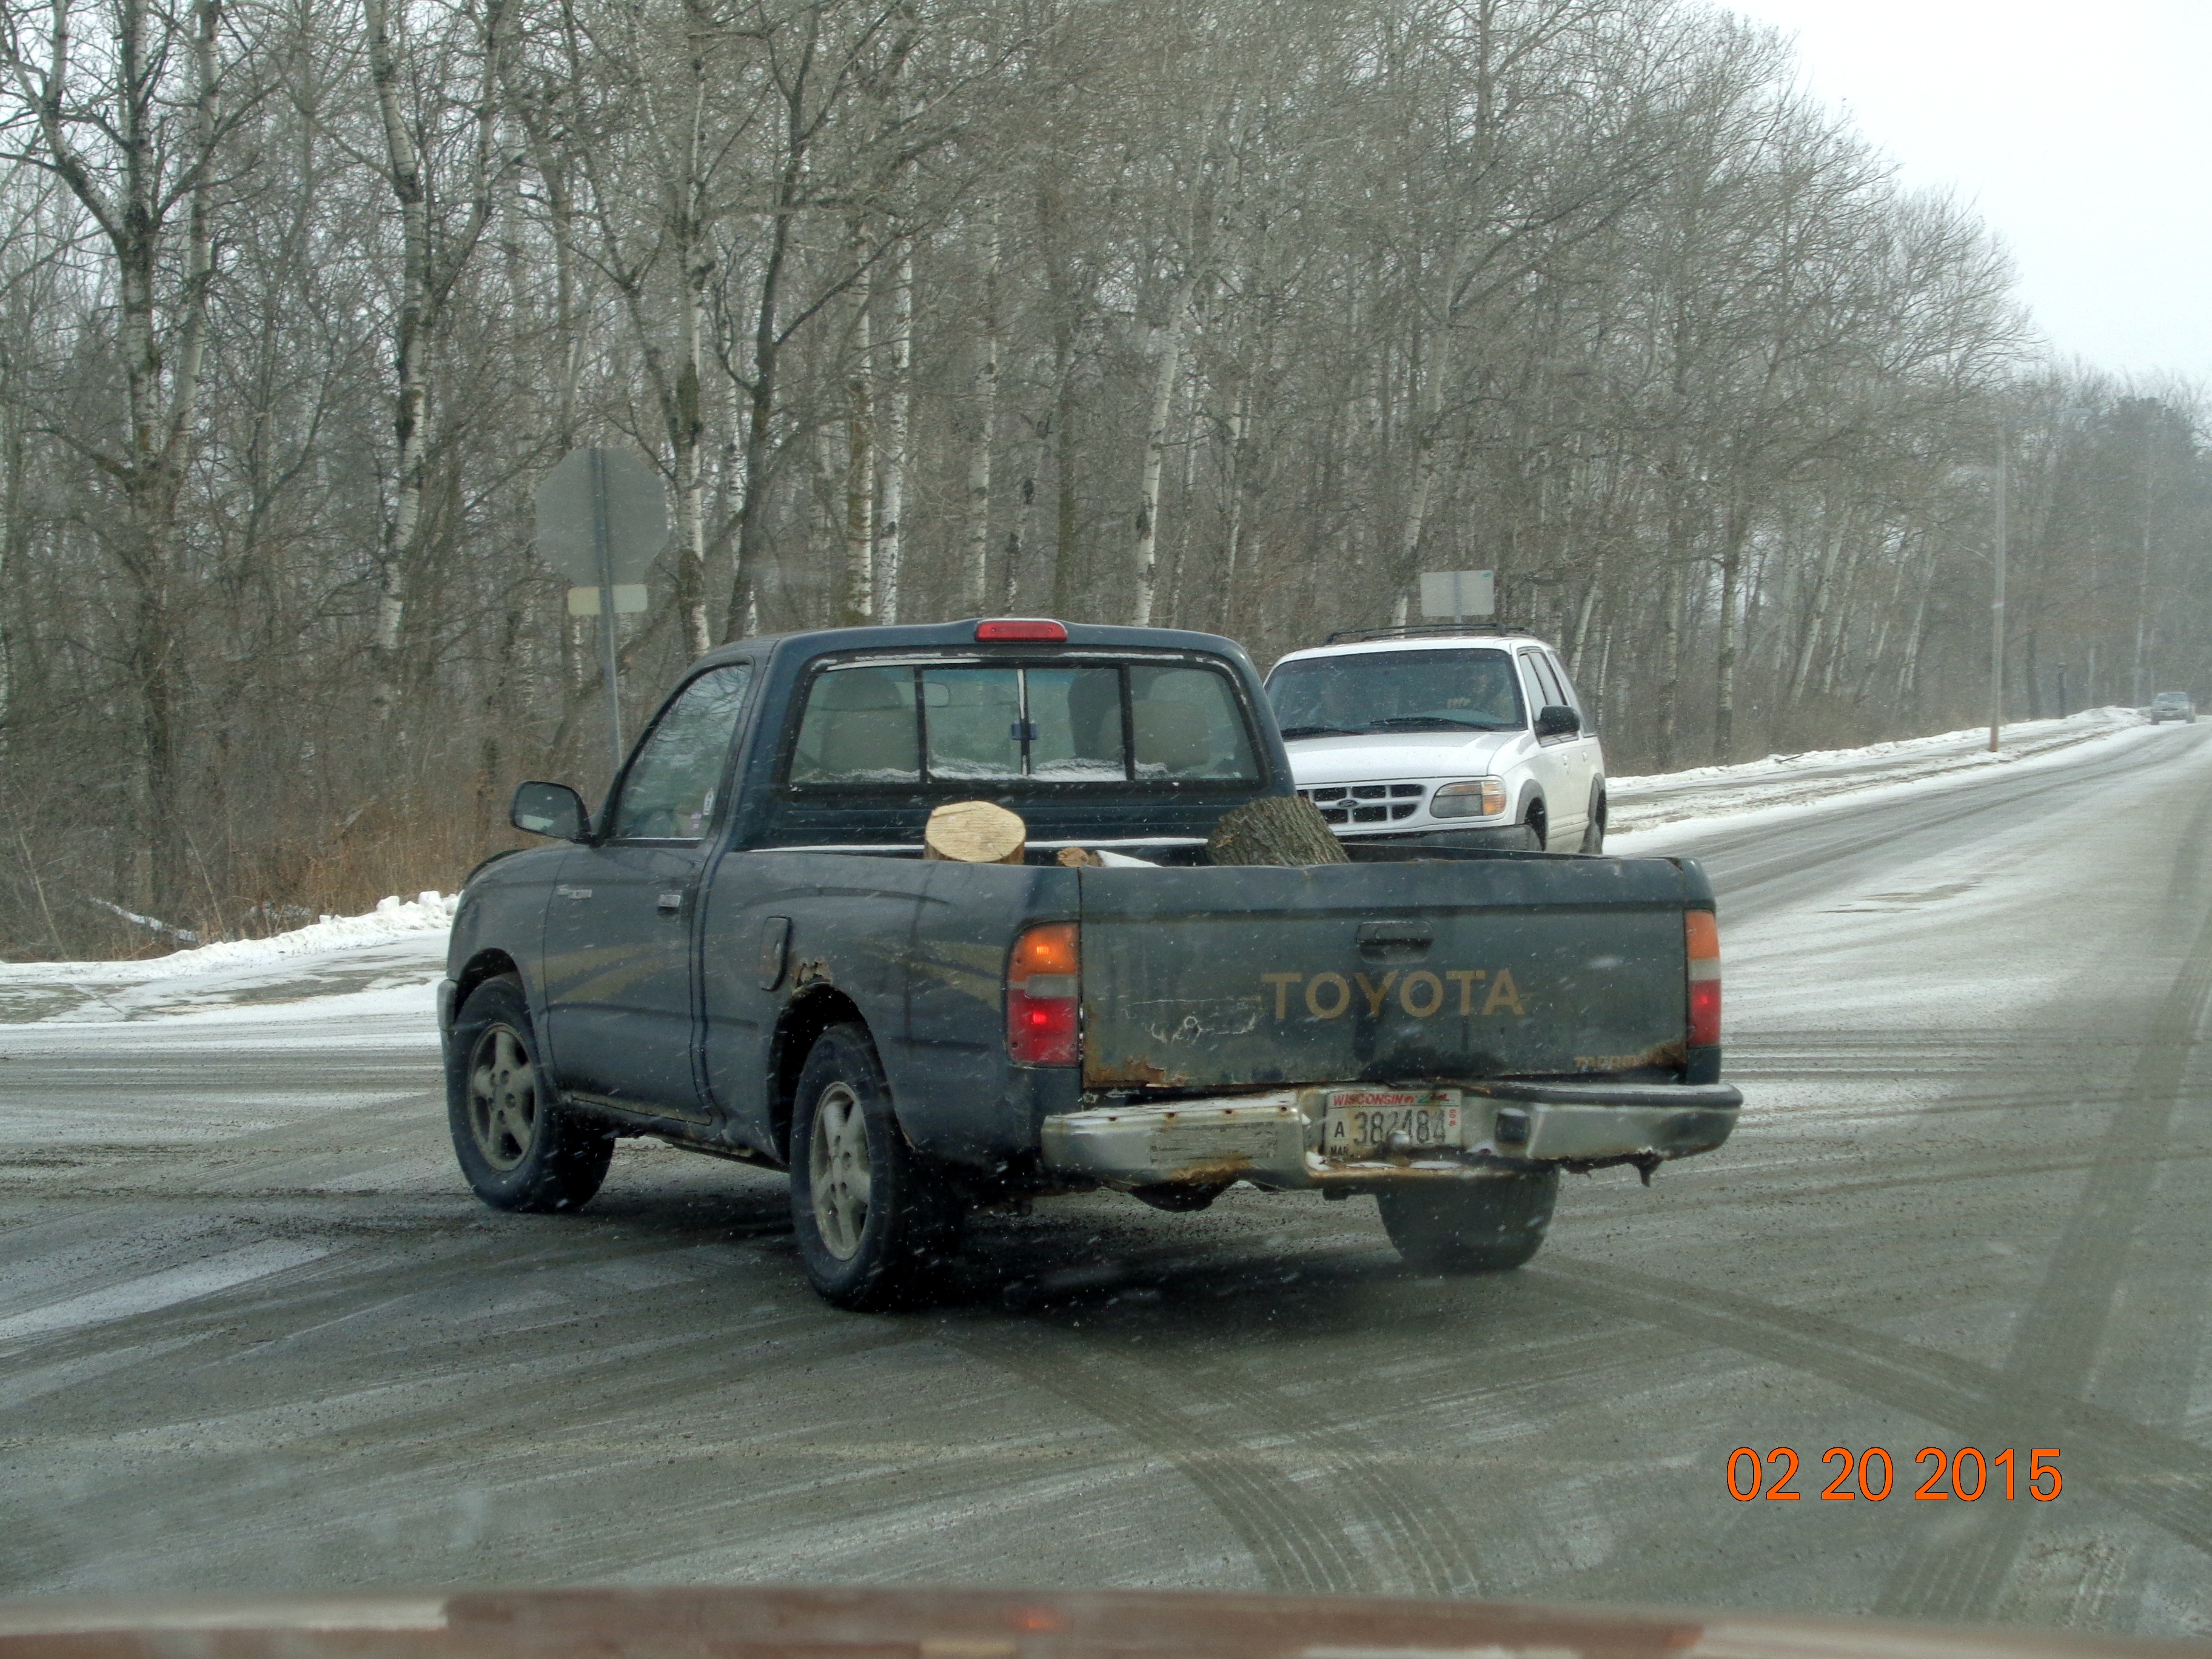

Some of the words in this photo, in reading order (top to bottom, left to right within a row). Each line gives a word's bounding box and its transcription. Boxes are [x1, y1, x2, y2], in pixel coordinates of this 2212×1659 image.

[1261, 970, 1524, 1019] TOYOTA
[1334, 1093, 1404, 1106] WISCONSIN
[1335, 1121, 1344, 1138] A
